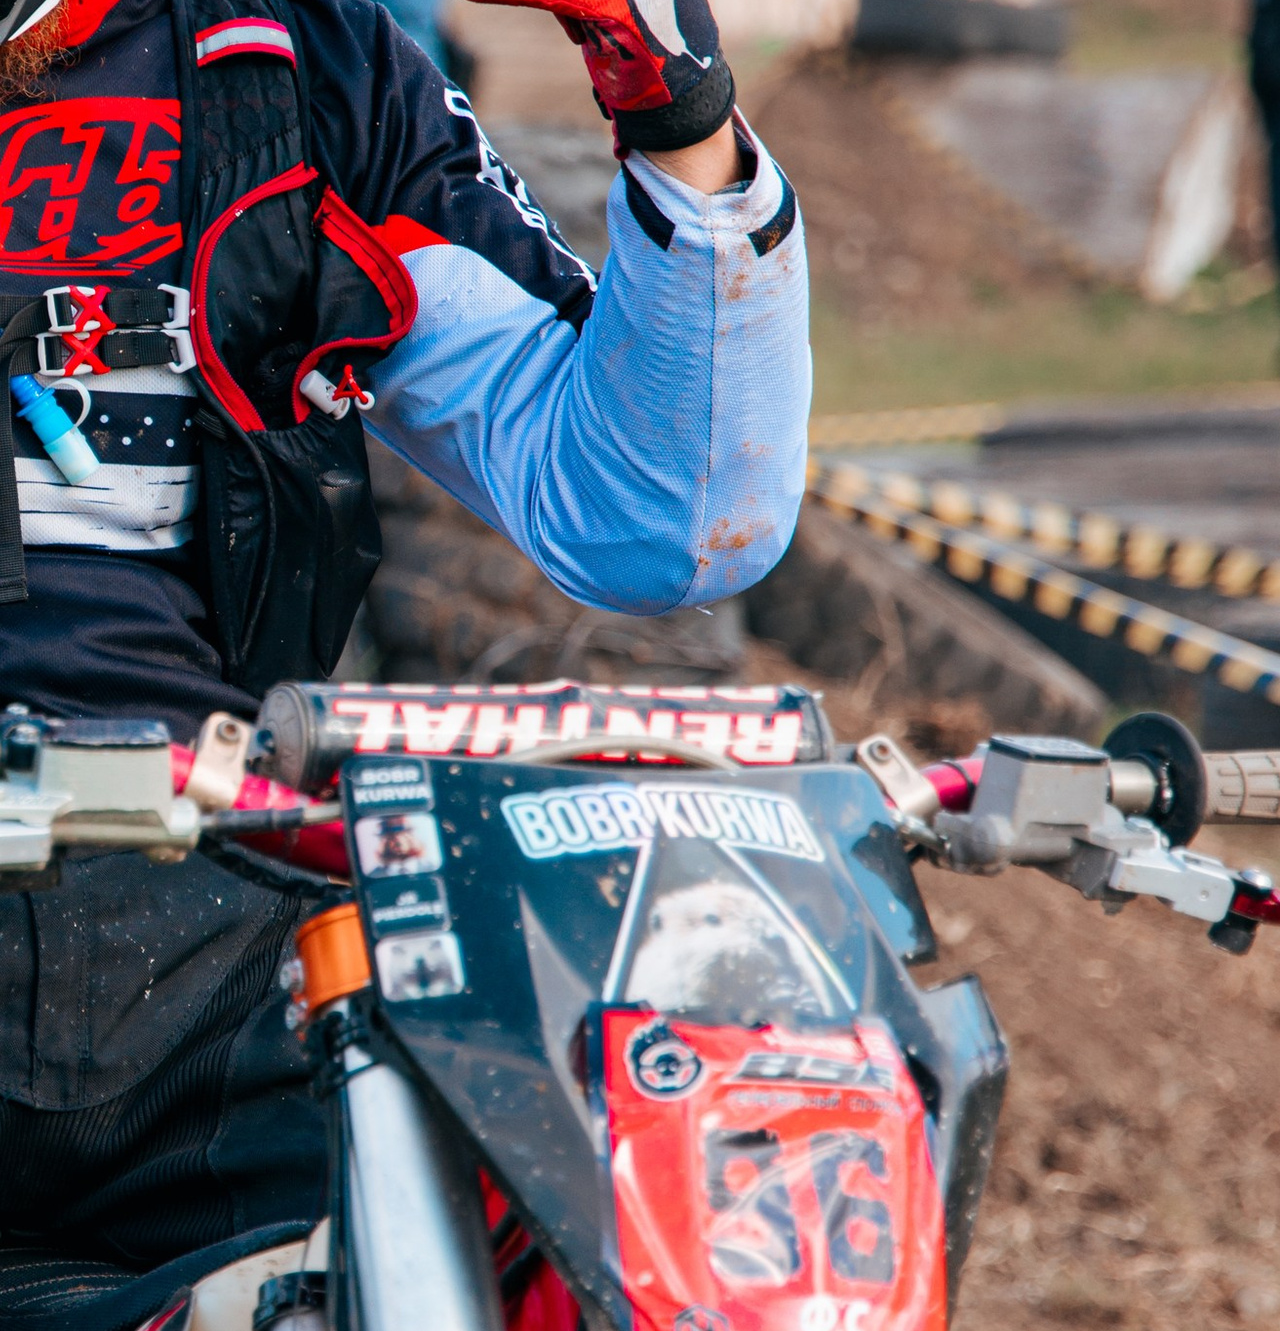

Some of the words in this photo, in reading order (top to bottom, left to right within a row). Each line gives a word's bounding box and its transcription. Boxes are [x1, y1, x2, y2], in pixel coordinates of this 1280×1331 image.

[333, 698, 803, 766] RENTHAL
[354, 785, 432, 804] KURWA
[361, 769, 420, 785] BOBR
[512, 791, 655, 852] BOBR
[648, 790, 816, 855] KURWA
